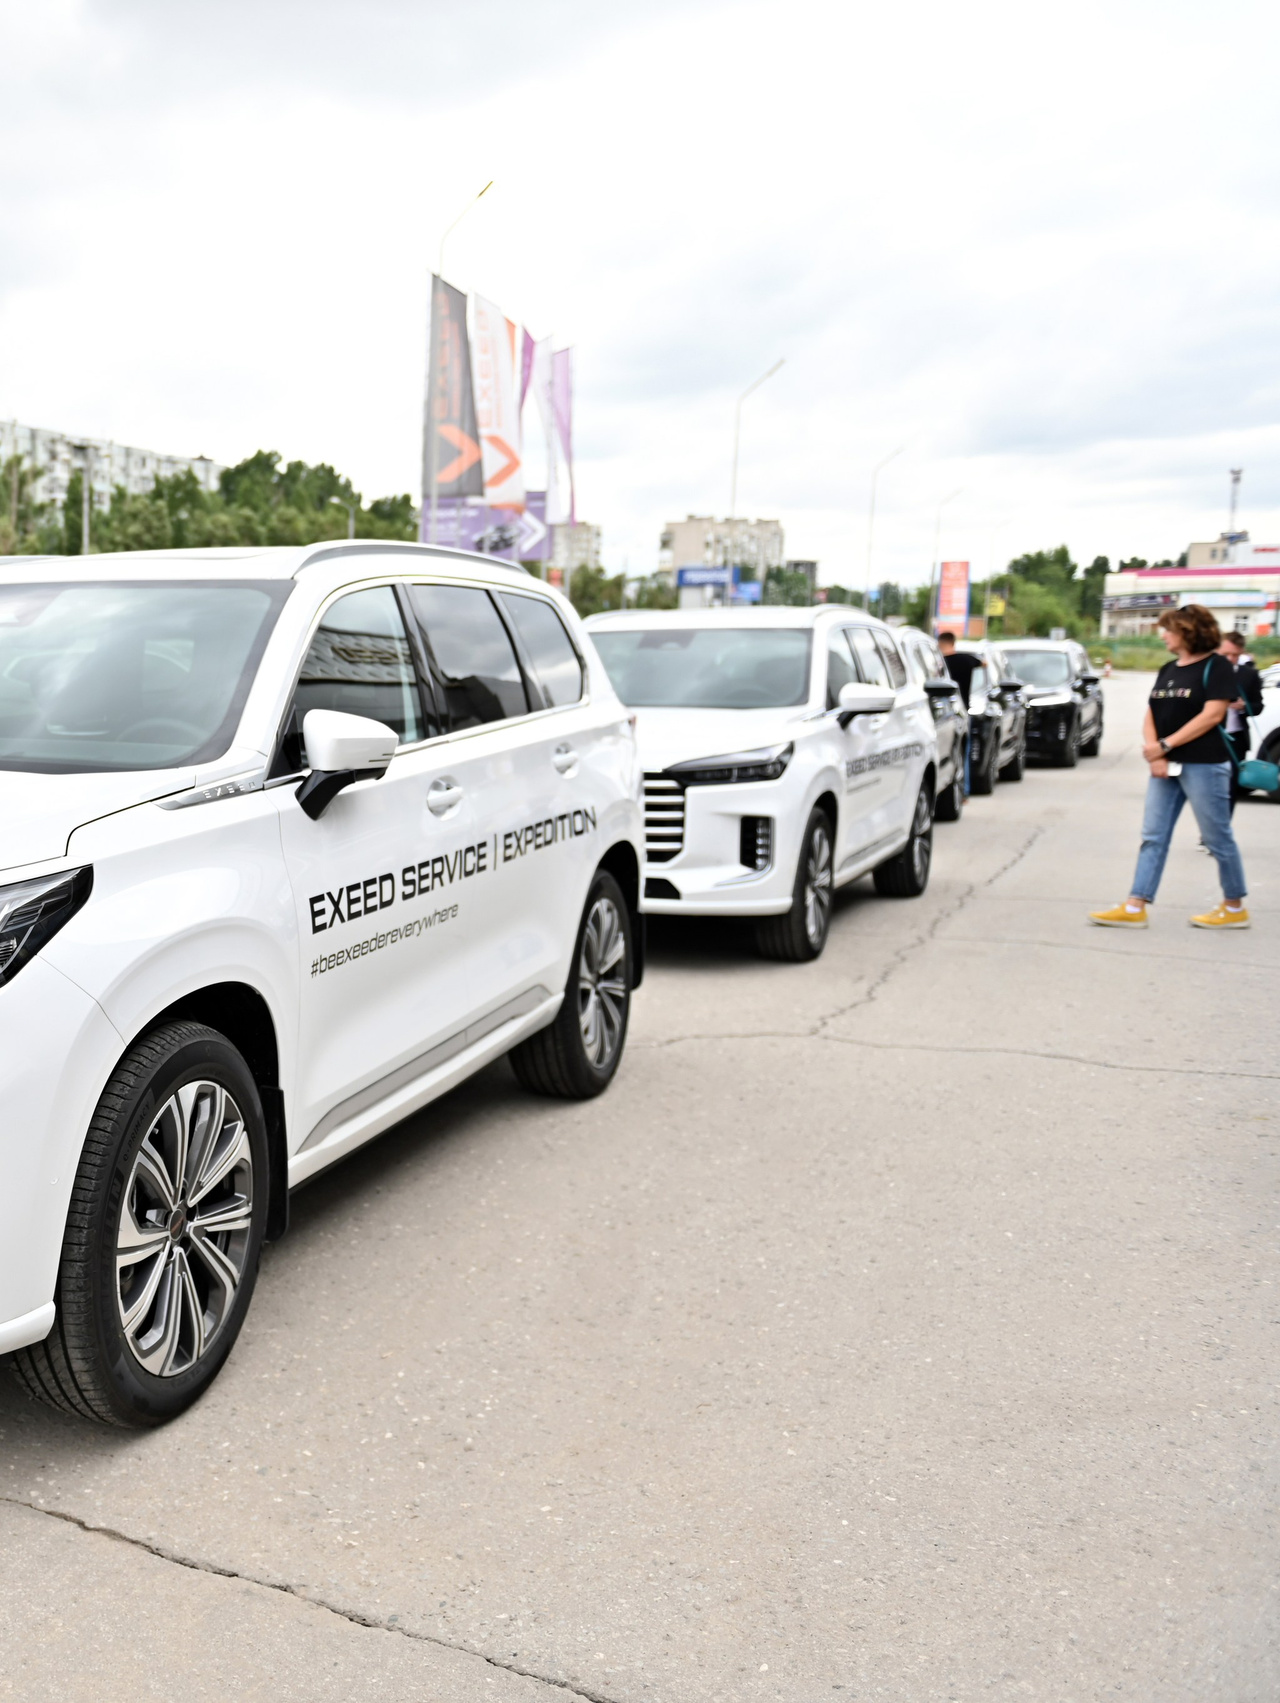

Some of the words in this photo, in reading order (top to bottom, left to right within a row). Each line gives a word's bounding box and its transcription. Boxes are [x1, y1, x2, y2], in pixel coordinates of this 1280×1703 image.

[203, 781, 256, 799] EXEED
[309, 872, 396, 935] EXEED
[401, 840, 488, 901] SERVICE
[503, 805, 598, 863] EXPEDITION
[311, 903, 459, 979] #beexeedereverywhere
